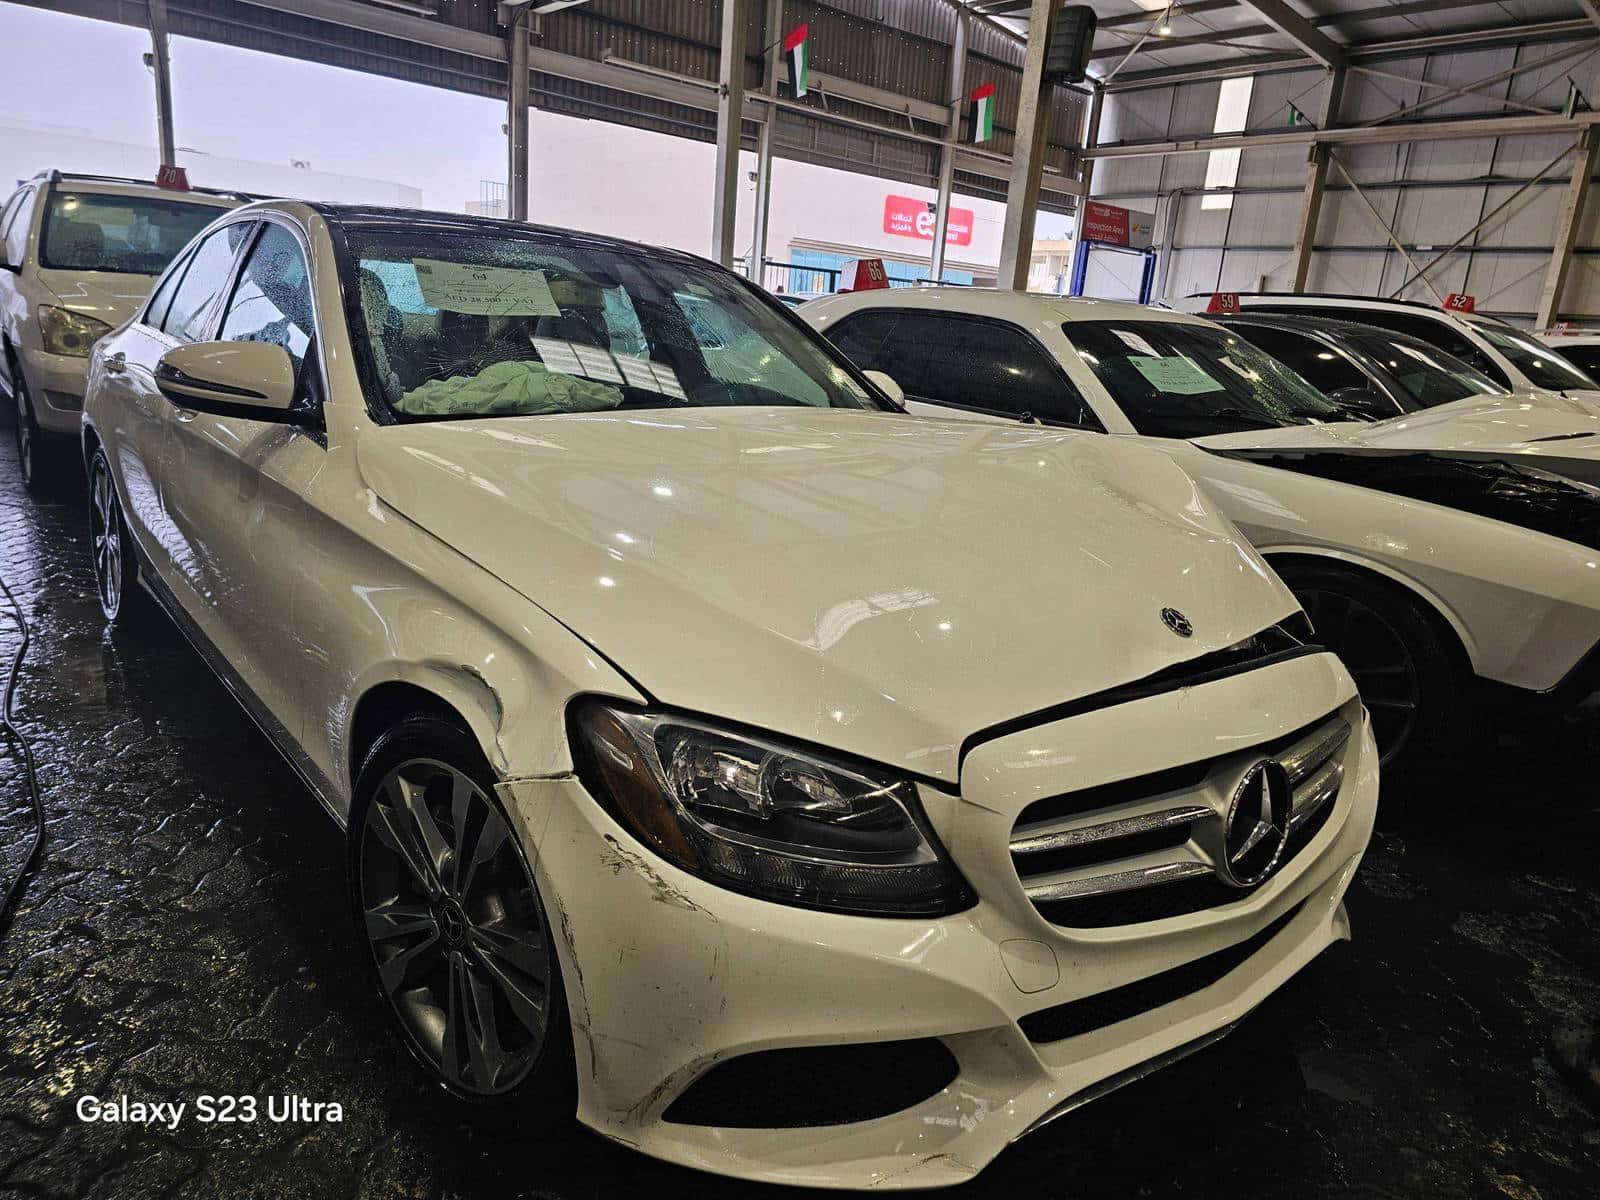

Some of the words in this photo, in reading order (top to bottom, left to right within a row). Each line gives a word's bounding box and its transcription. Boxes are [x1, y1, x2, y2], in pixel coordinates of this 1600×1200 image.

[163, 168, 177, 184] 70
[868, 260, 882, 281] 66
[1221, 294, 1234, 309] 59
[1452, 295, 1467, 308] 52
